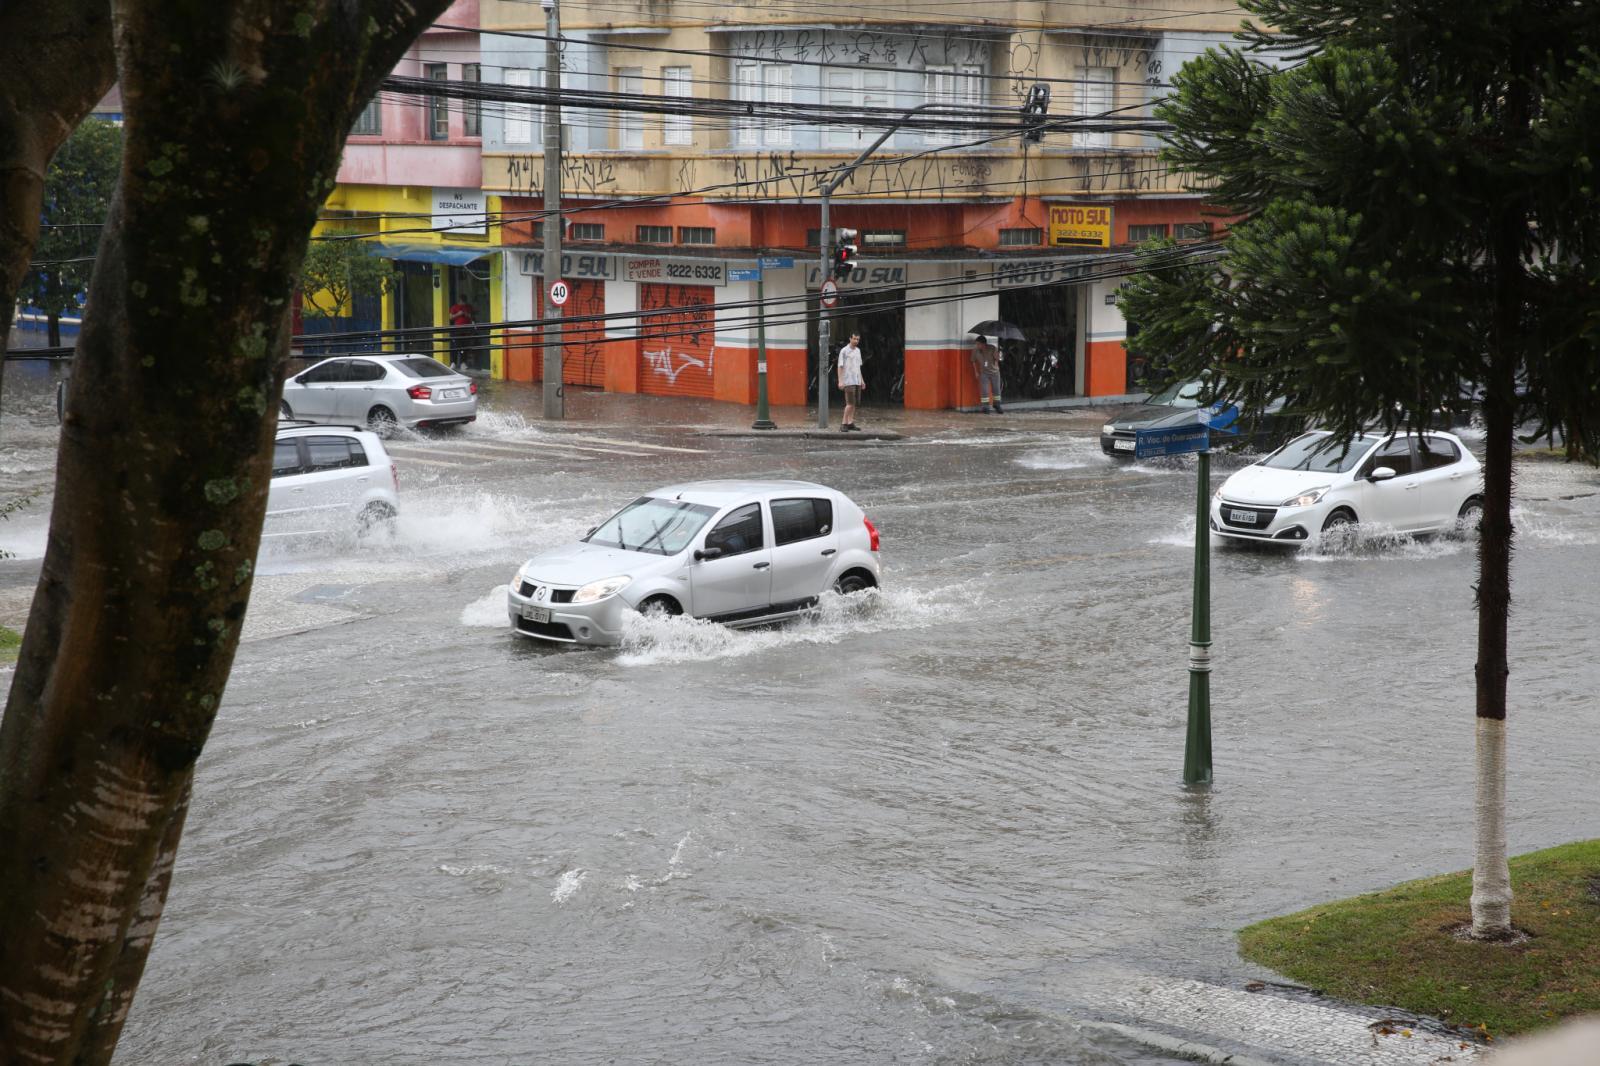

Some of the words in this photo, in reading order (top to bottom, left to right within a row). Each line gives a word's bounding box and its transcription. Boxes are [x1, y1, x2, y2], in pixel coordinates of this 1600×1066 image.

[439, 201, 478, 210] DESPACHANTE
[1051, 207, 1084, 225] MOTO
[1086, 209, 1109, 226] SUL
[1056, 230, 1103, 238] 3222-6332
[577, 255, 610, 277] SUL
[628, 259, 661, 270] COMPRA
[629, 271, 634, 279] E
[637, 269, 662, 279] VENDE
[869, 267, 905, 283] SUL
[552, 286, 566, 298] 40
